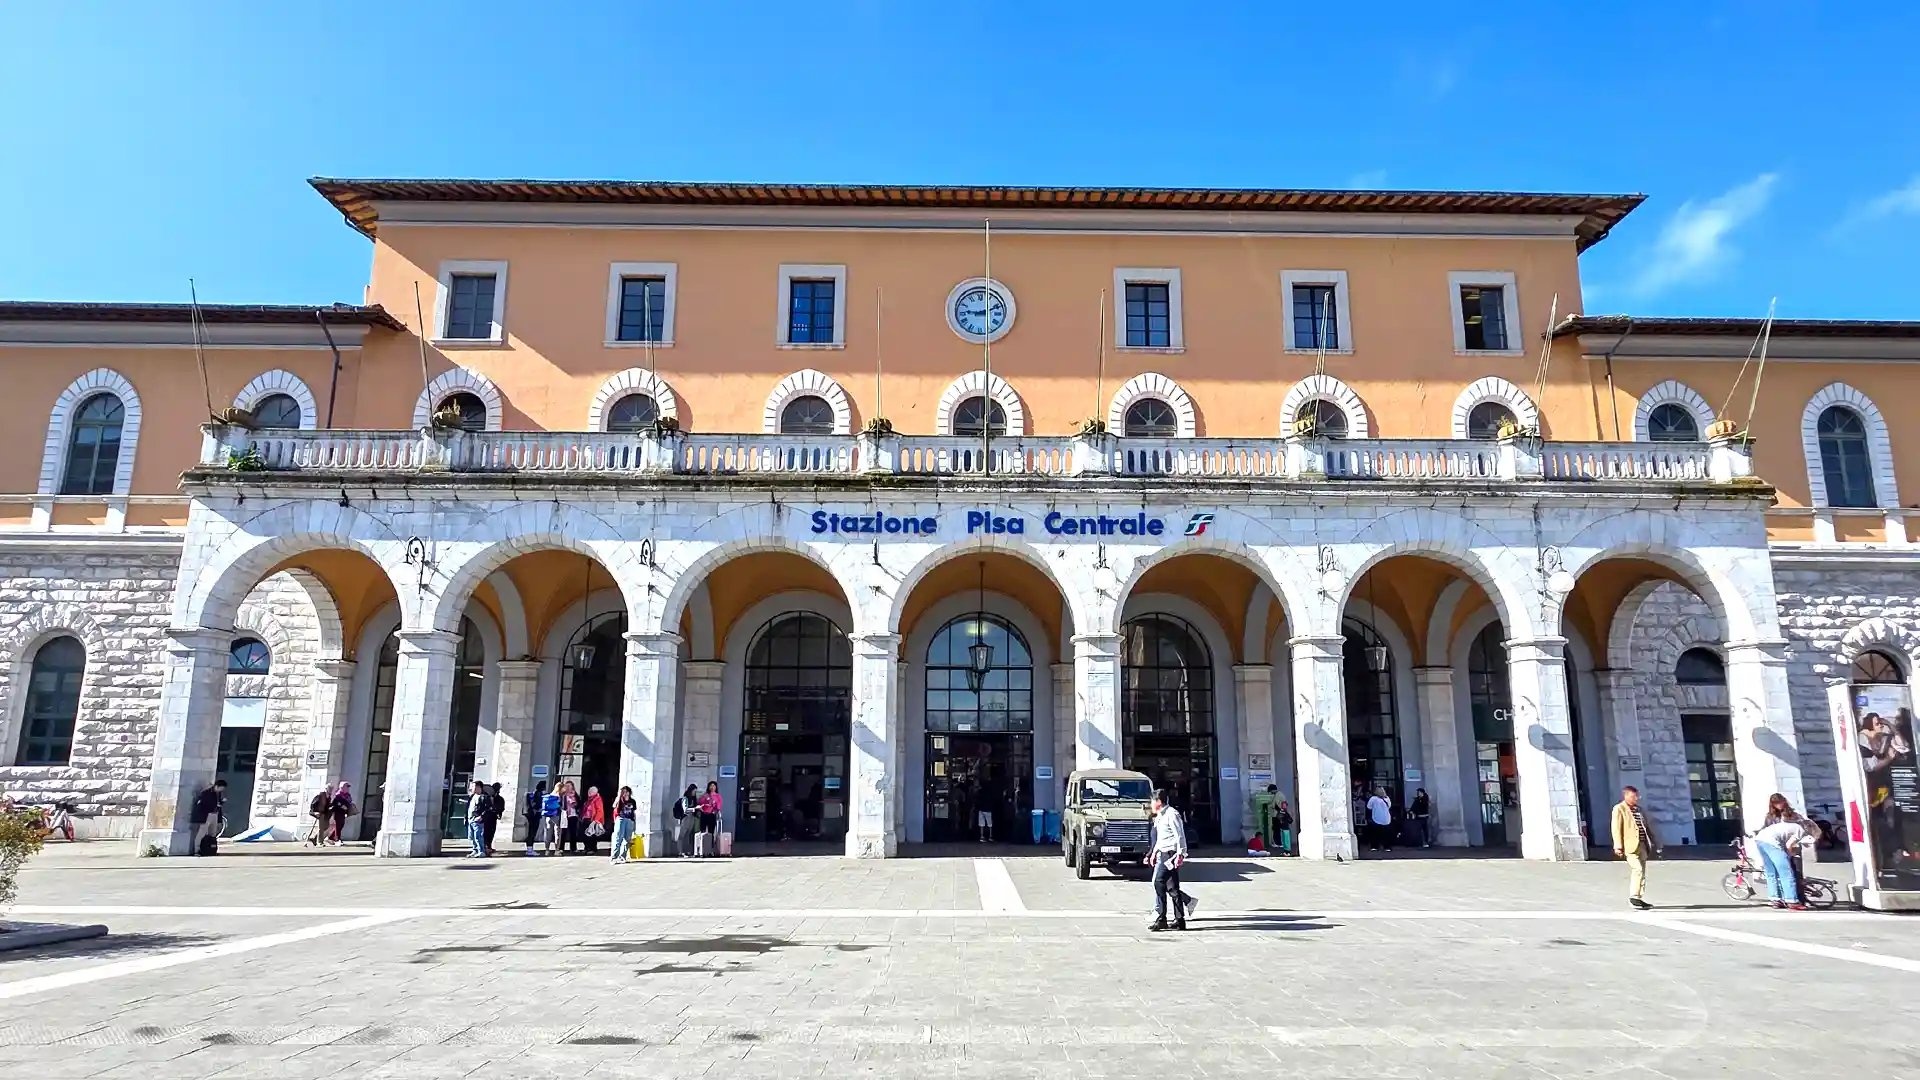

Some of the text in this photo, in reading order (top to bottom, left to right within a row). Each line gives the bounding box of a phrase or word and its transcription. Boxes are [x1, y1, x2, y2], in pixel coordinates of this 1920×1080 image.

[811, 511, 1165, 535] Stazione Pisa Centrale
